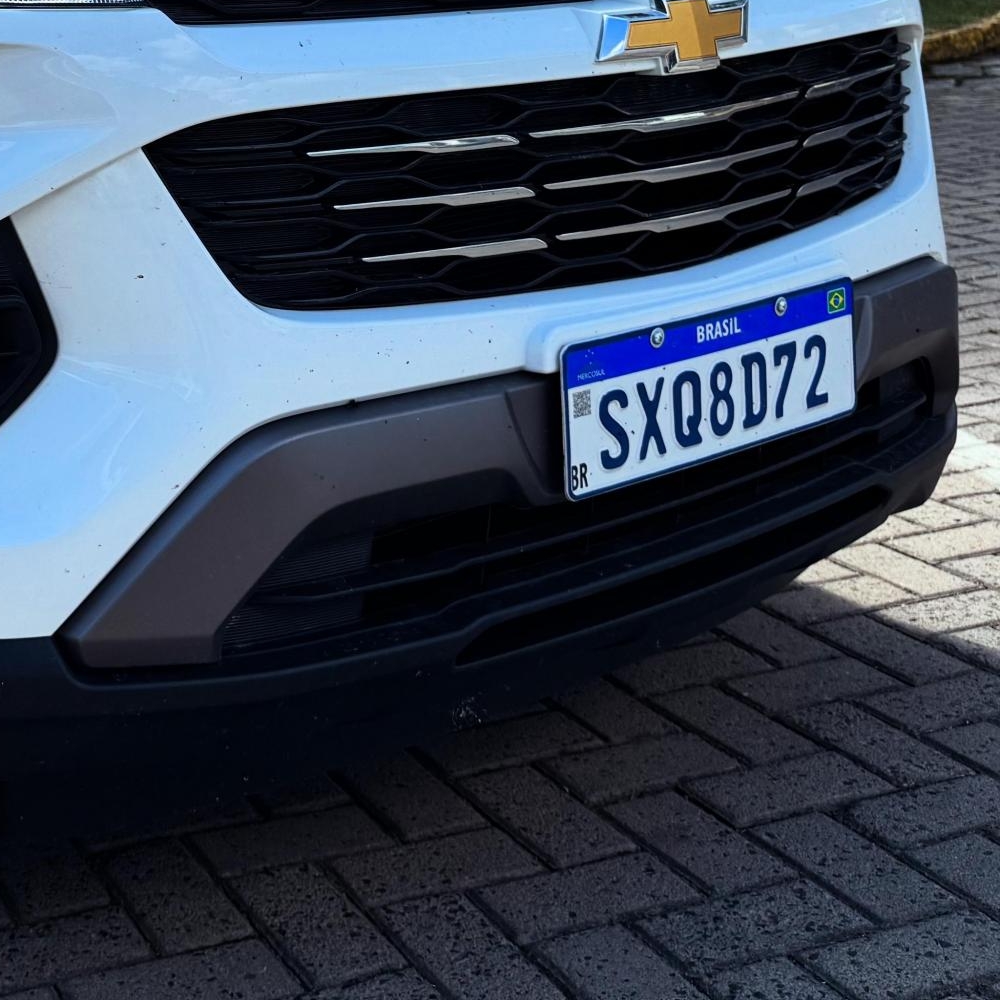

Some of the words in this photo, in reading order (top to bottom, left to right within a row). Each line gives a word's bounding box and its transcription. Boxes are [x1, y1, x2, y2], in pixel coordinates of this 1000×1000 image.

[696, 316, 742, 344] BRASIL
[577, 369, 605, 381] MERCOSUL
[598, 334, 829, 470] SXQ8D72
[571, 463, 588, 491] BR
